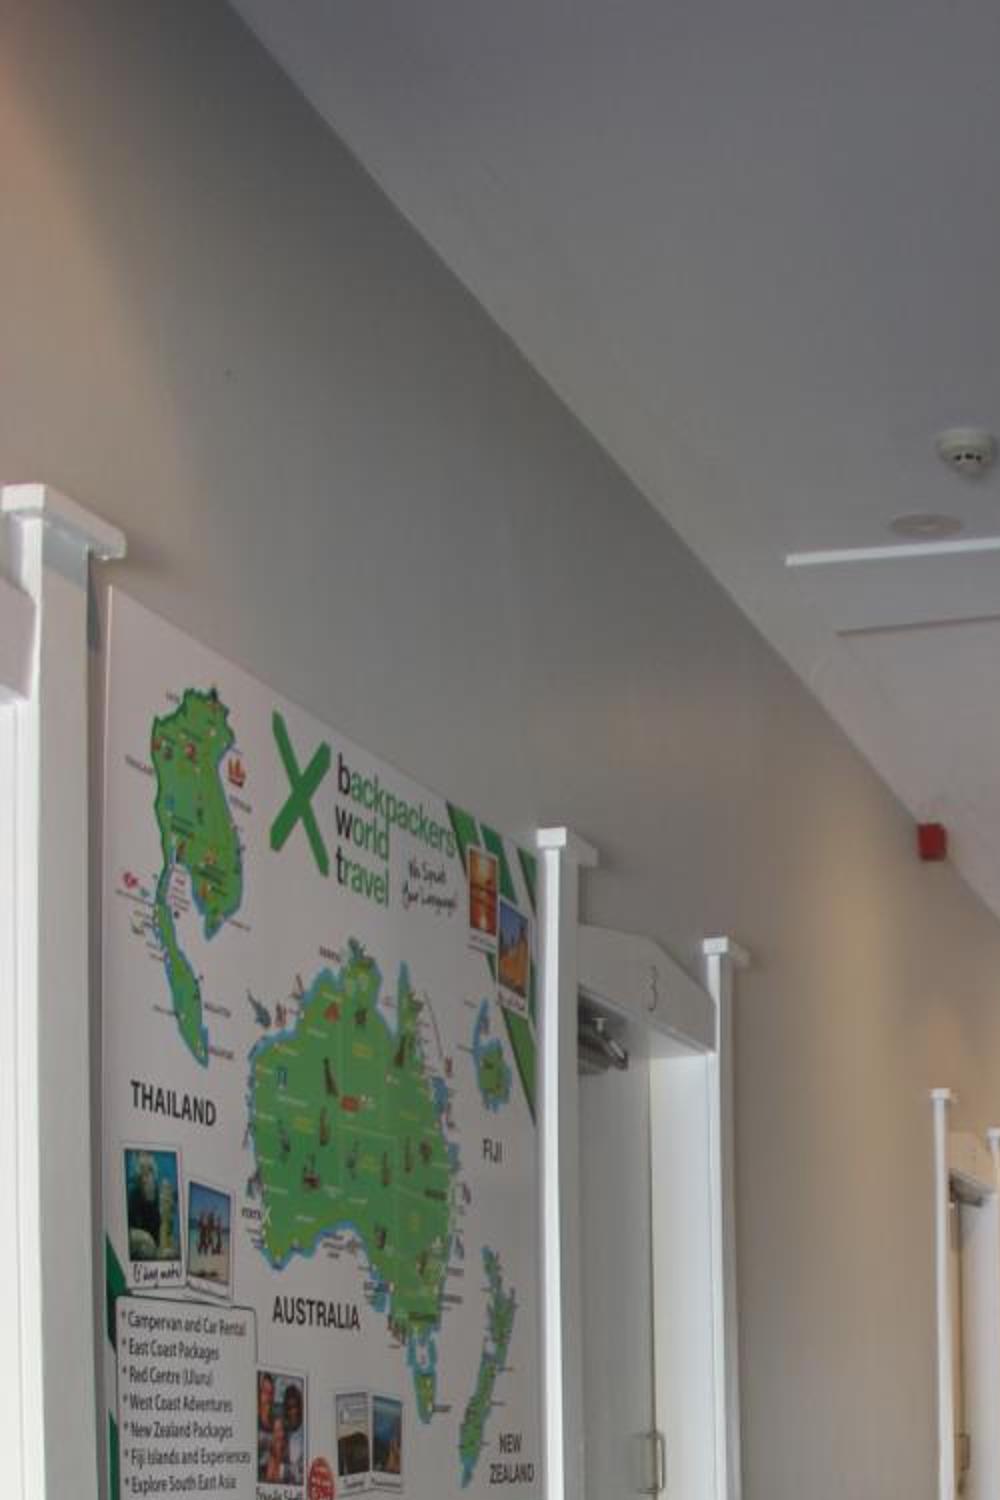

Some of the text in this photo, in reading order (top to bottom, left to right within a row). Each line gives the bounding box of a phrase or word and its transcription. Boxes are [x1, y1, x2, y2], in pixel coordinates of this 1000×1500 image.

[338, 752, 456, 858] backpackers
[335, 804, 389, 862] world
[336, 846, 389, 908] travel
[130, 1079, 217, 1127] THAILAND
[483, 1137, 503, 1163] FIJI
[128, 1311, 247, 1337] Campervan and Car Rental
[272, 1295, 361, 1331] AUSTRALIA
[129, 1337, 220, 1364] East Coast Packages
[129, 1365, 148, 1384] Red
[151, 1366, 180, 1385] Centre
[129, 1392, 233, 1413] West Coast Adventures
[131, 1420, 233, 1443] New Zealand Packages
[499, 1432, 523, 1453] NEW
[131, 1448, 145, 1469] Fiji
[147, 1448, 180, 1465] Islands
[182, 1448, 199, 1465] and
[131, 1473, 237, 1496] Explore South East Asia
[489, 1463, 535, 1485] ZEALAND
